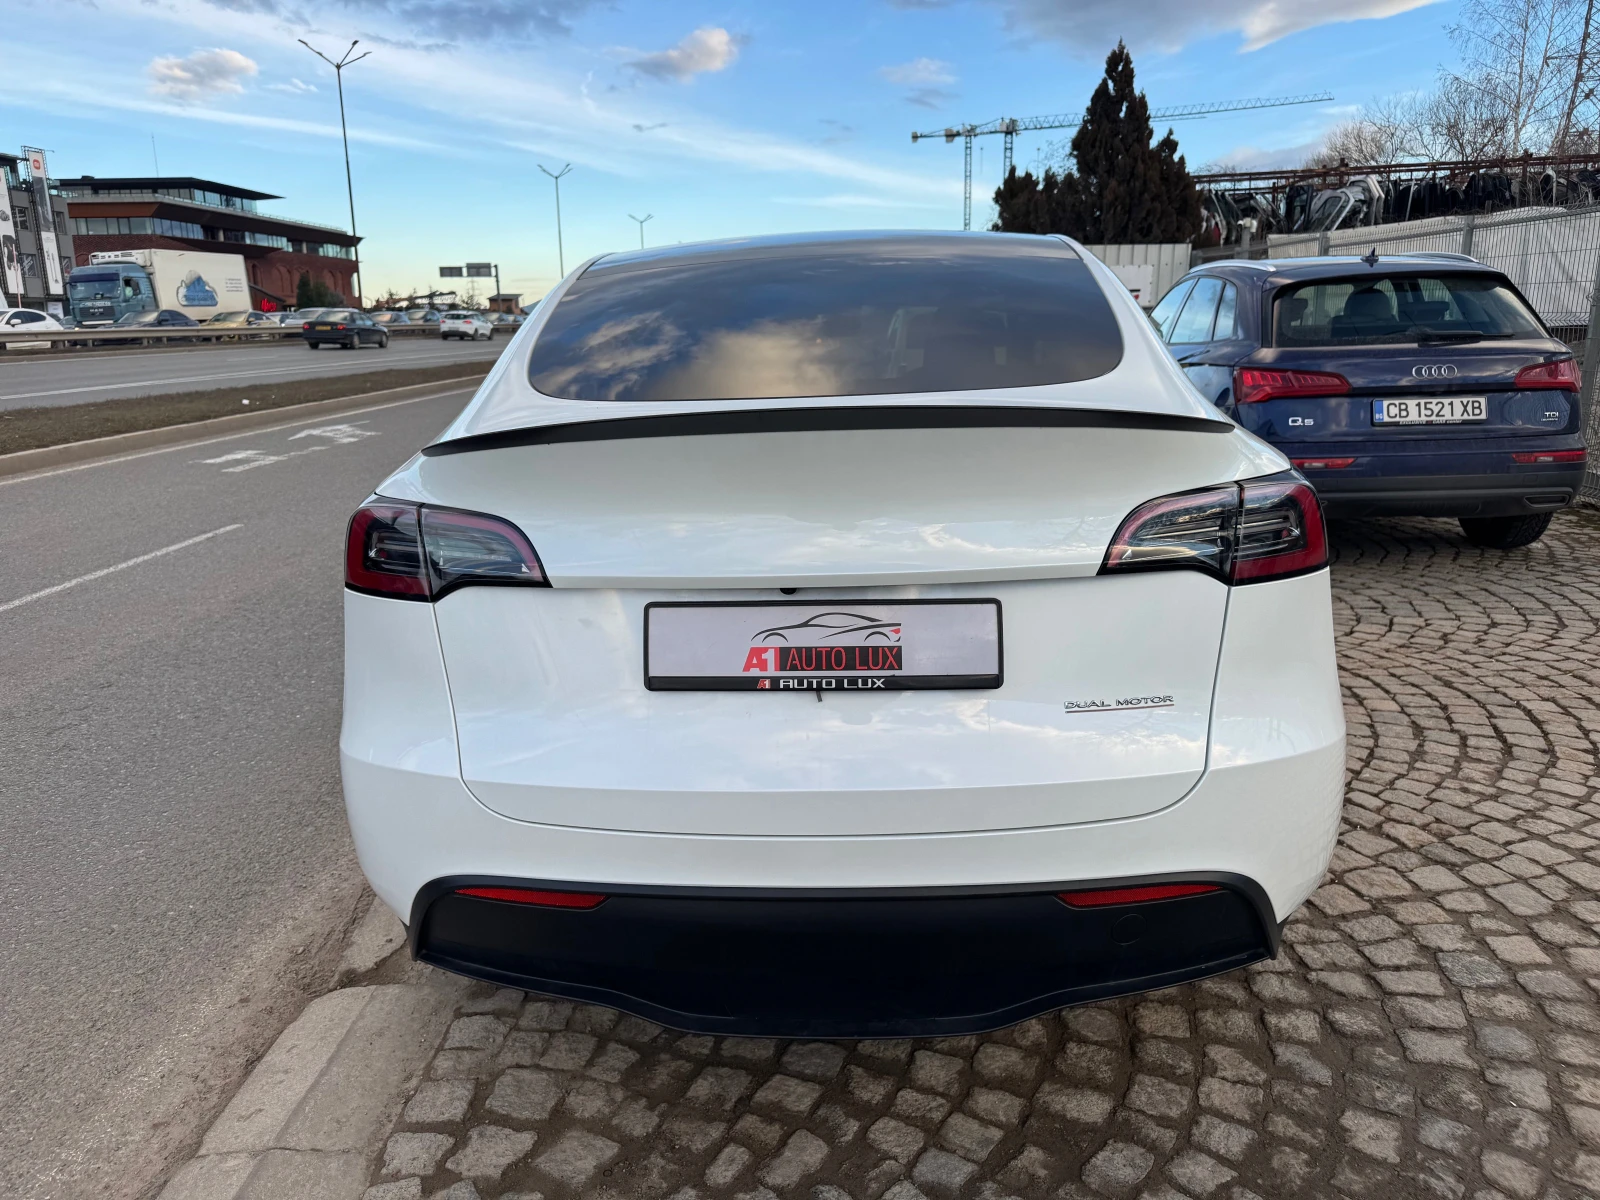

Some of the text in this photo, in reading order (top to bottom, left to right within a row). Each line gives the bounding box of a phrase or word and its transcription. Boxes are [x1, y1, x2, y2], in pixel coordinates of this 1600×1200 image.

[1386, 400, 1483, 419] CB 1521 XB
[1288, 416, 1314, 426] Q5
[742, 647, 899, 672] A1 AUTO LUX
[757, 678, 886, 689] A1 AUTO LUX
[1064, 695, 1175, 710] DUAL MOTOR
